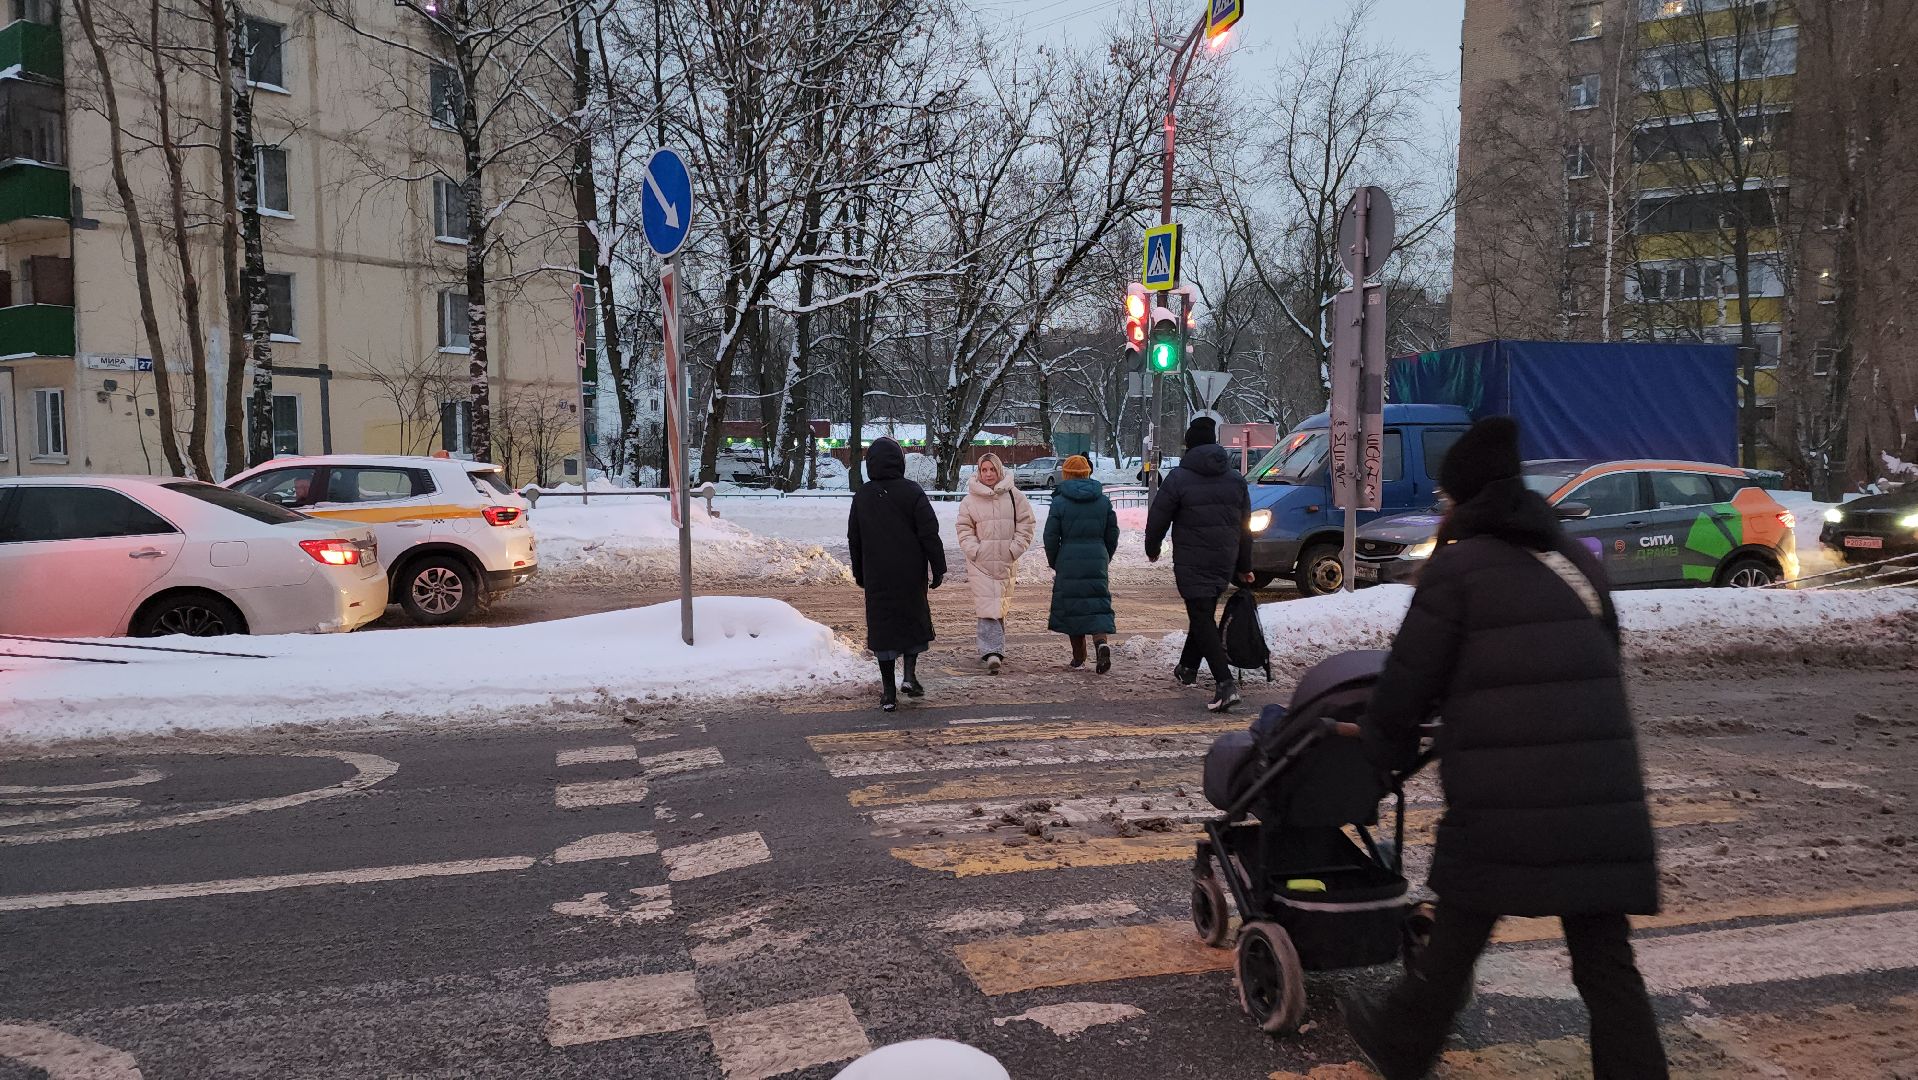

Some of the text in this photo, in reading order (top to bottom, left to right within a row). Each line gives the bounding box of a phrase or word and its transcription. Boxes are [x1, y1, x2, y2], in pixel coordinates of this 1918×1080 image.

[100, 357, 127, 365] МИРА
[139, 361, 153, 370] 27
[1639, 534, 1675, 548] СИТИ
[1635, 545, 1679, 560] ДРАЙВ
